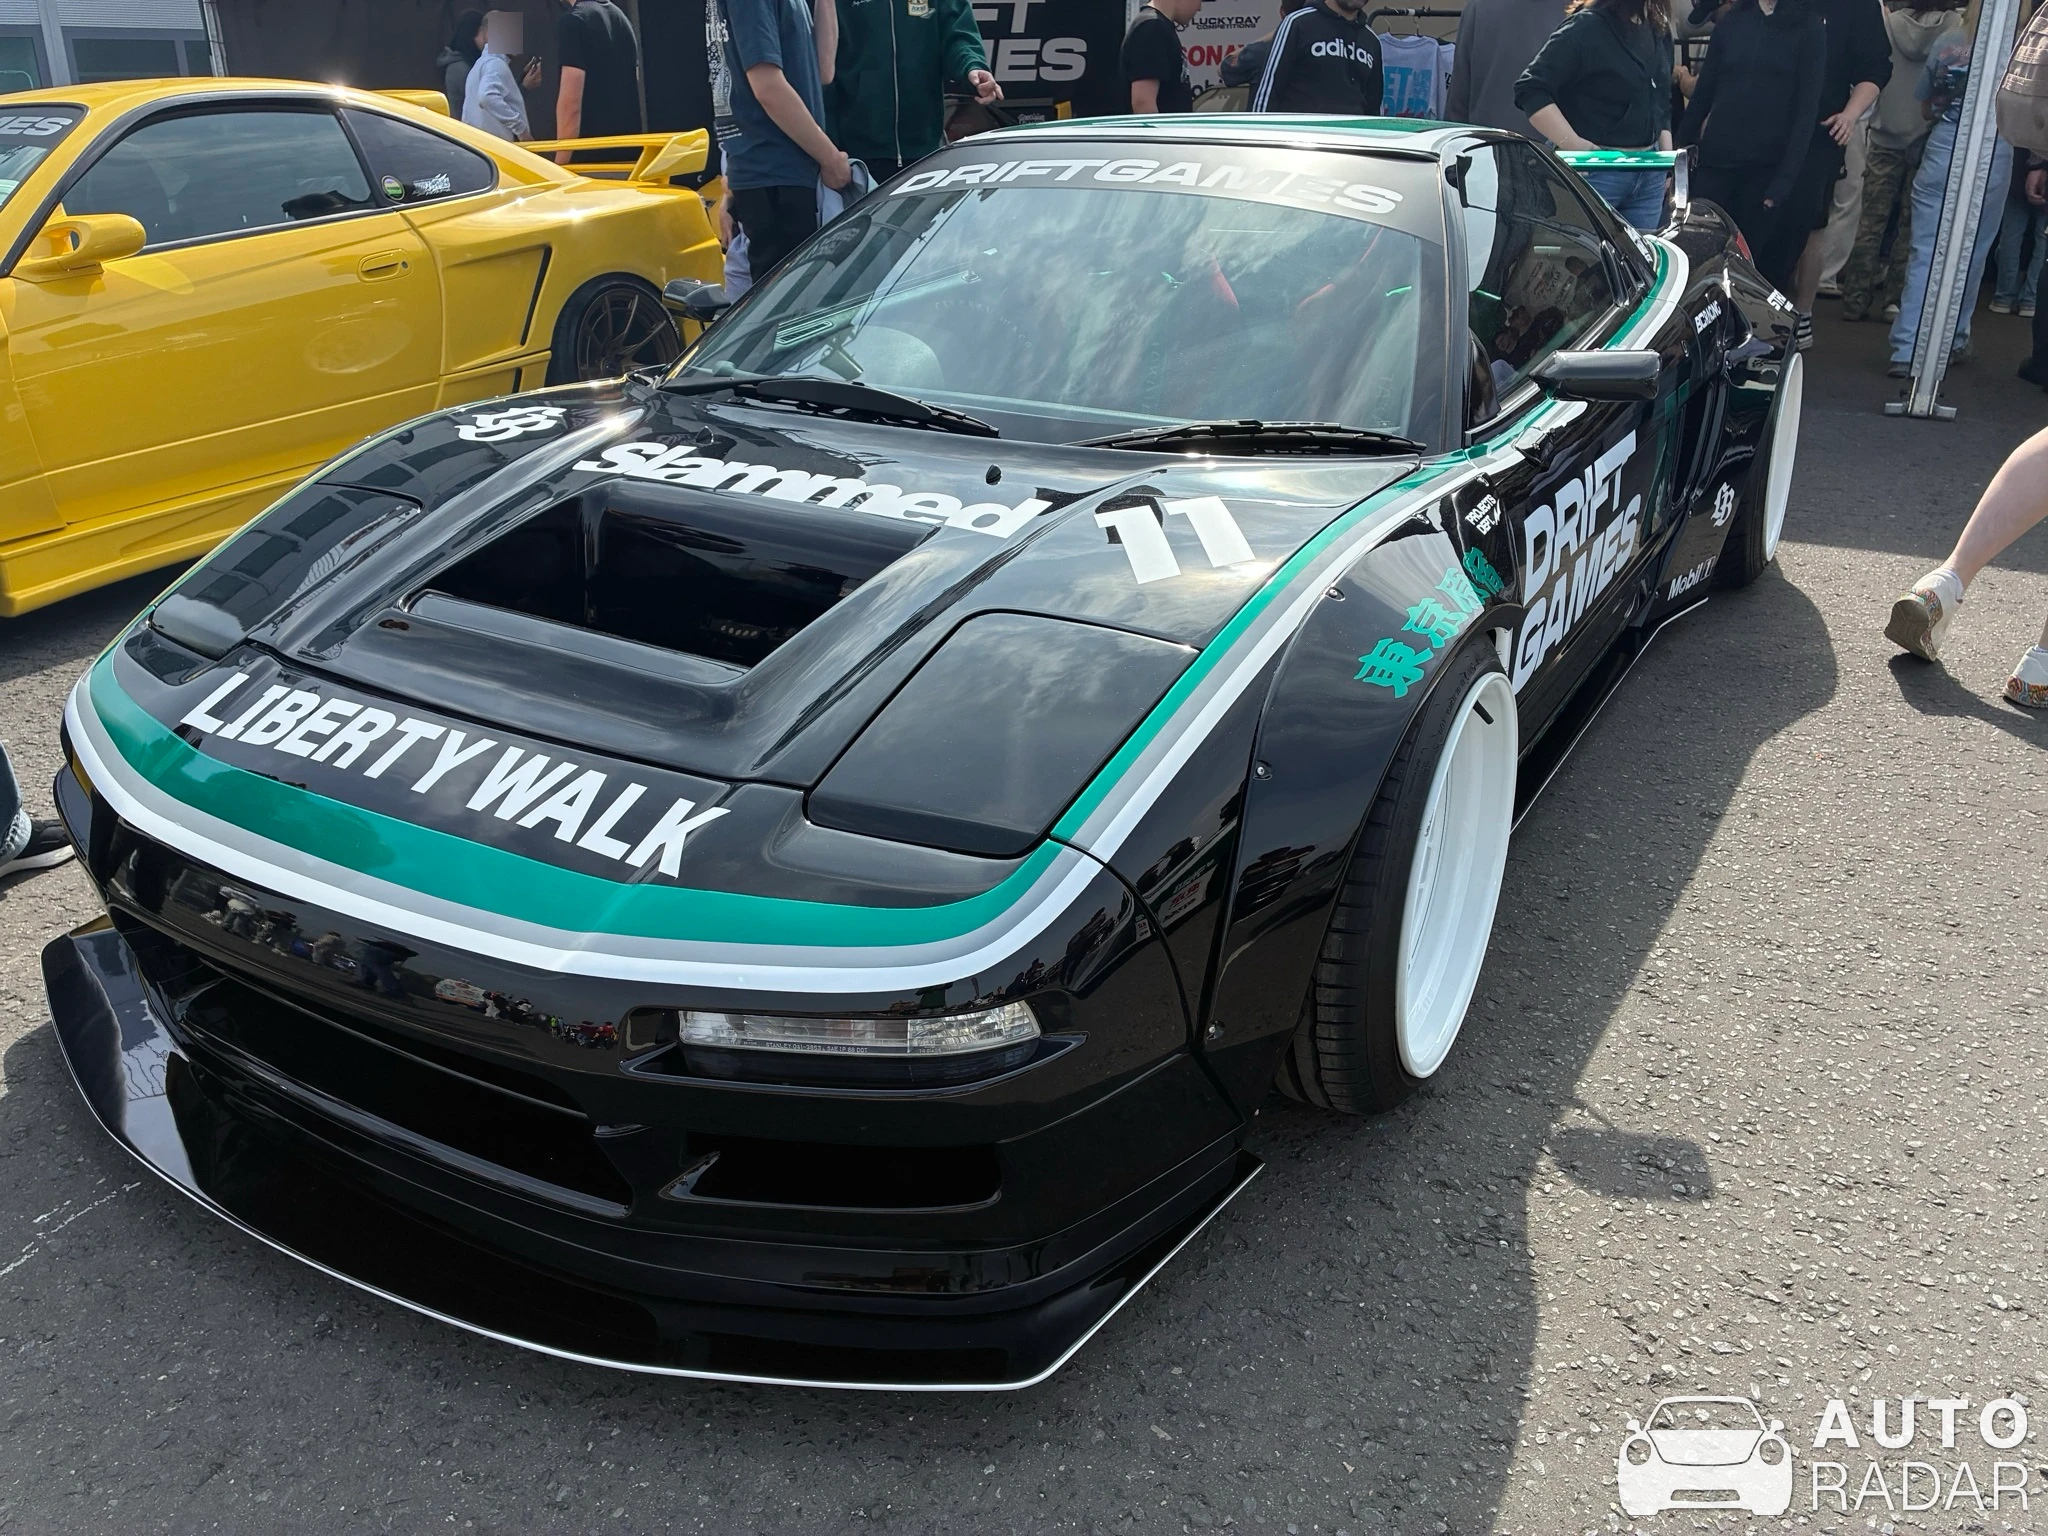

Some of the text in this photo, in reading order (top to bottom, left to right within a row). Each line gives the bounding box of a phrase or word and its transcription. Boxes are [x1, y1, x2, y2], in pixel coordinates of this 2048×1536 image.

[1191, 16, 1261, 25] LUCKYDAY
[979, 37, 1087, 81] ES
[1311, 38, 1374, 69] adidas
[889, 159, 1403, 214] DRIFTGAMES
[572, 442, 1053, 539] Slammed
[1465, 494, 1497, 525] PROJECTS
[1094, 496, 1256, 585] 11
[1476, 514, 1496, 536] DEPT.
[1523, 429, 1637, 608] DRIFT
[1511, 493, 1641, 695] GAMES
[1667, 562, 1703, 601] Mobil
[179, 672, 731, 879] LIBERTY WALK
[765, 1041, 792, 1049] STANLEY
